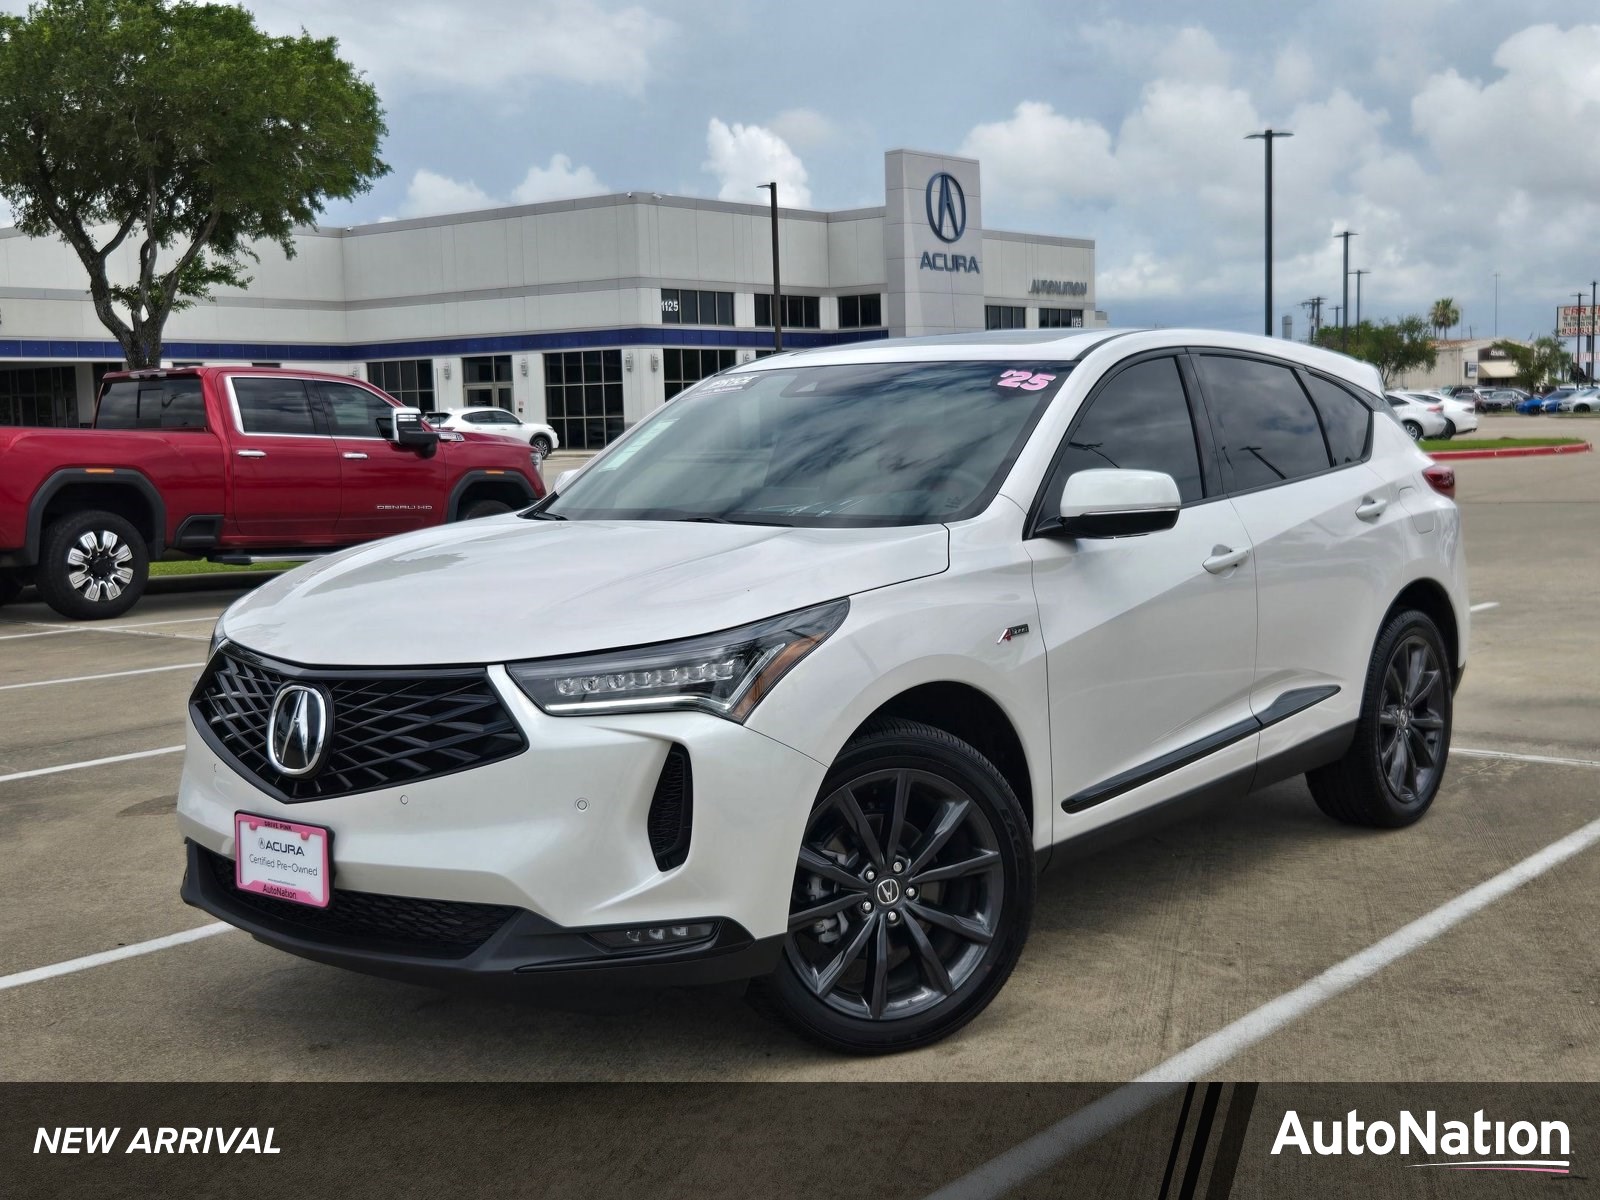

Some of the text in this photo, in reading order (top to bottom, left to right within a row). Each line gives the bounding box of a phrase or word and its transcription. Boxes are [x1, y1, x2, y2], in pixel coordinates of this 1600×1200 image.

[919, 251, 980, 275] ACURA
[661, 300, 679, 312] 1125
[1071, 316, 1082, 328] 1125
[264, 820, 293, 832] DRIVE PINK
[265, 840, 305, 856] ACURA
[249, 853, 318, 877] Certified Pre-Owned
[262, 883, 297, 900] AutoNation
